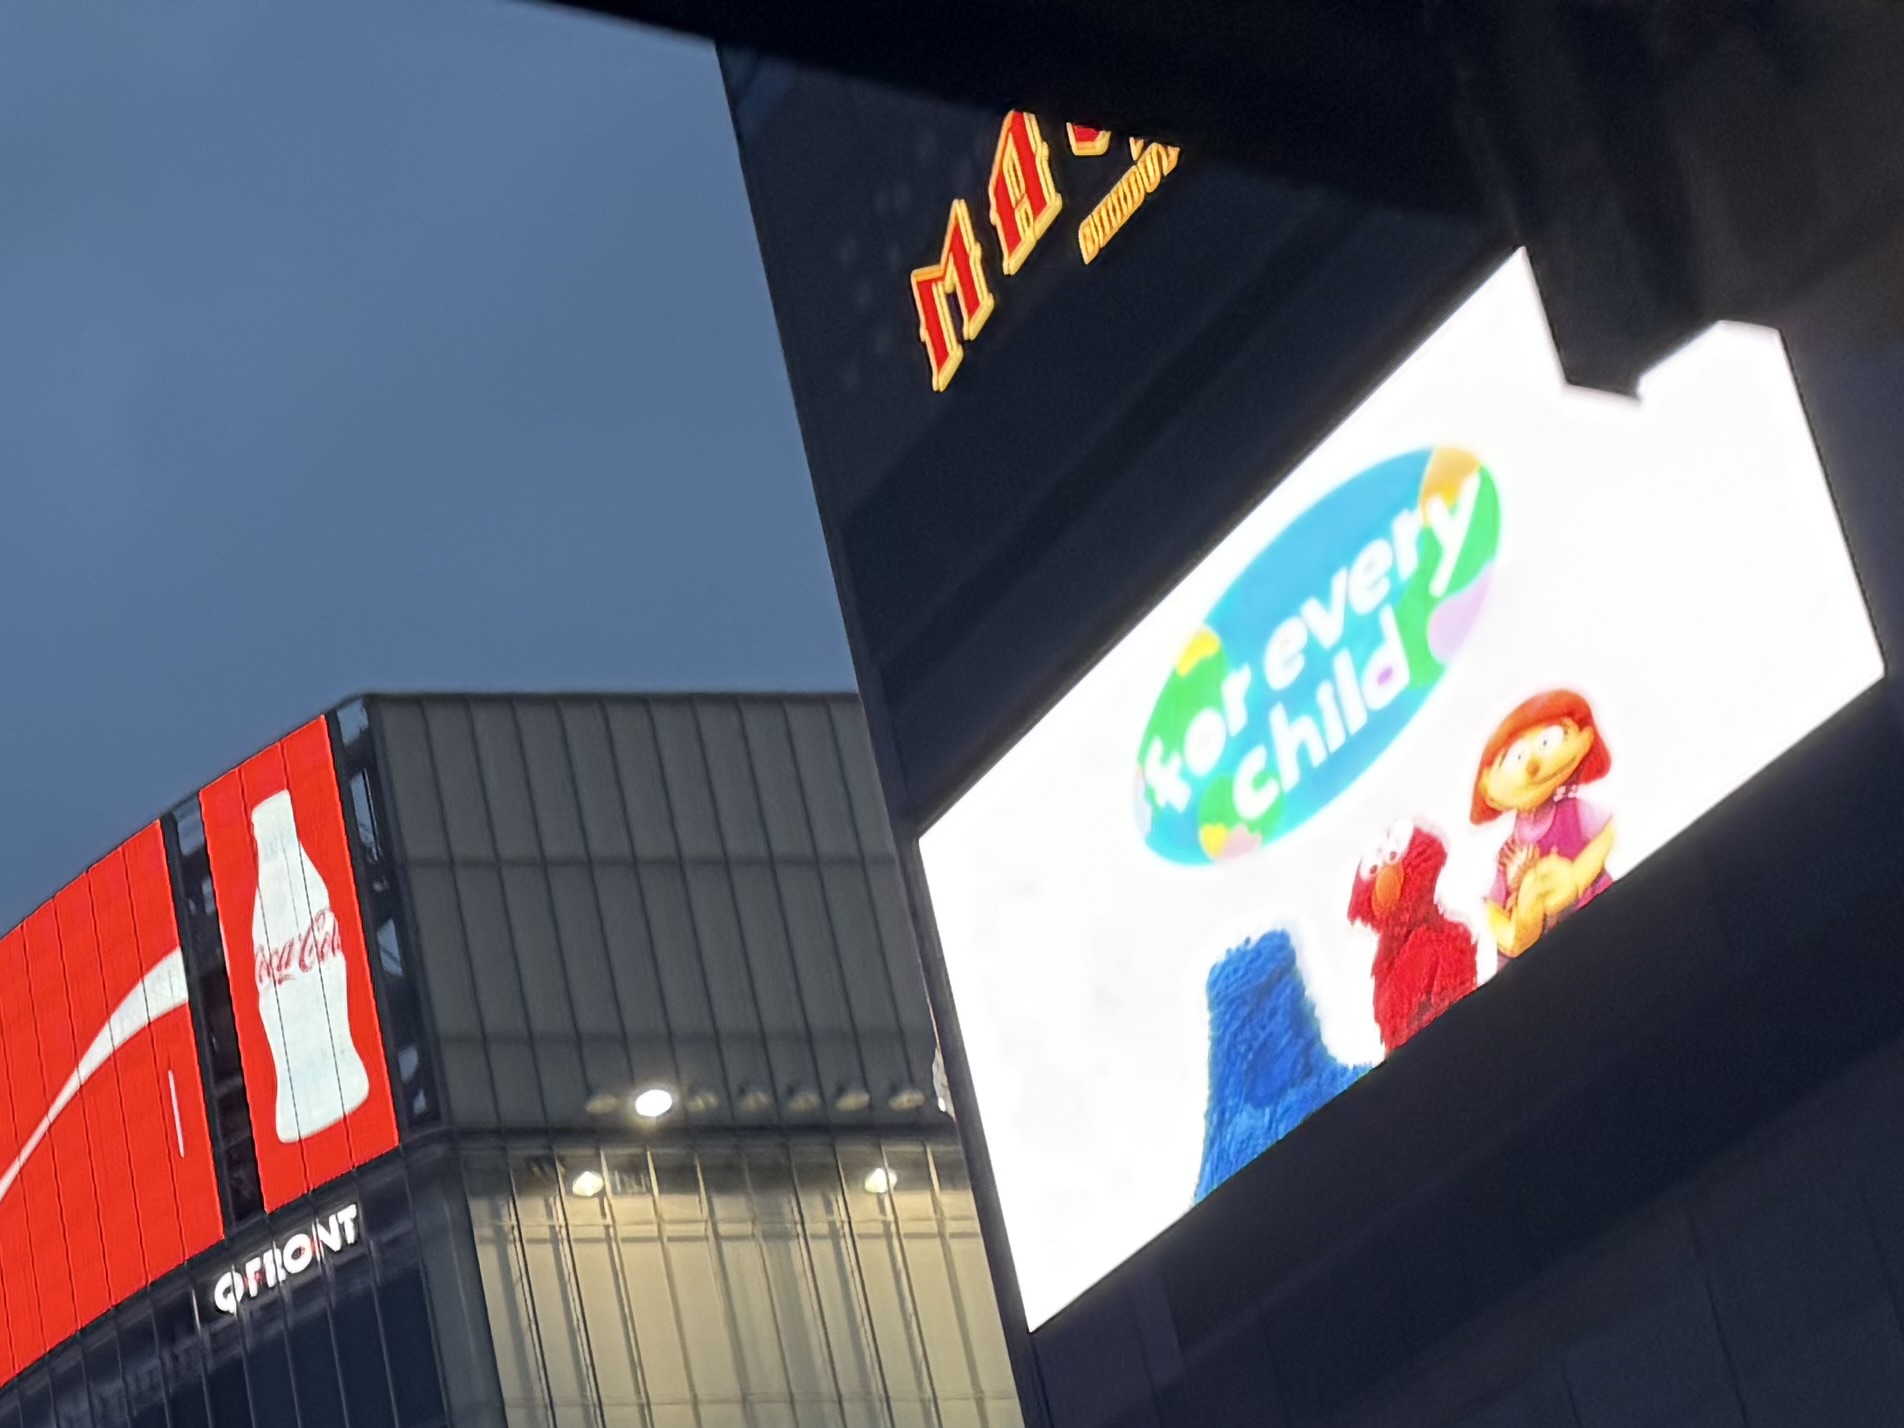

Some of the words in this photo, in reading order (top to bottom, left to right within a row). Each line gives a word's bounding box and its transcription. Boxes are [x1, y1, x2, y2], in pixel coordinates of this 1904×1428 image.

[1145, 655, 1253, 813] for
[1265, 473, 1481, 694] every
[1234, 606, 1410, 821] child
[214, 1203, 360, 1314] QFRONT
